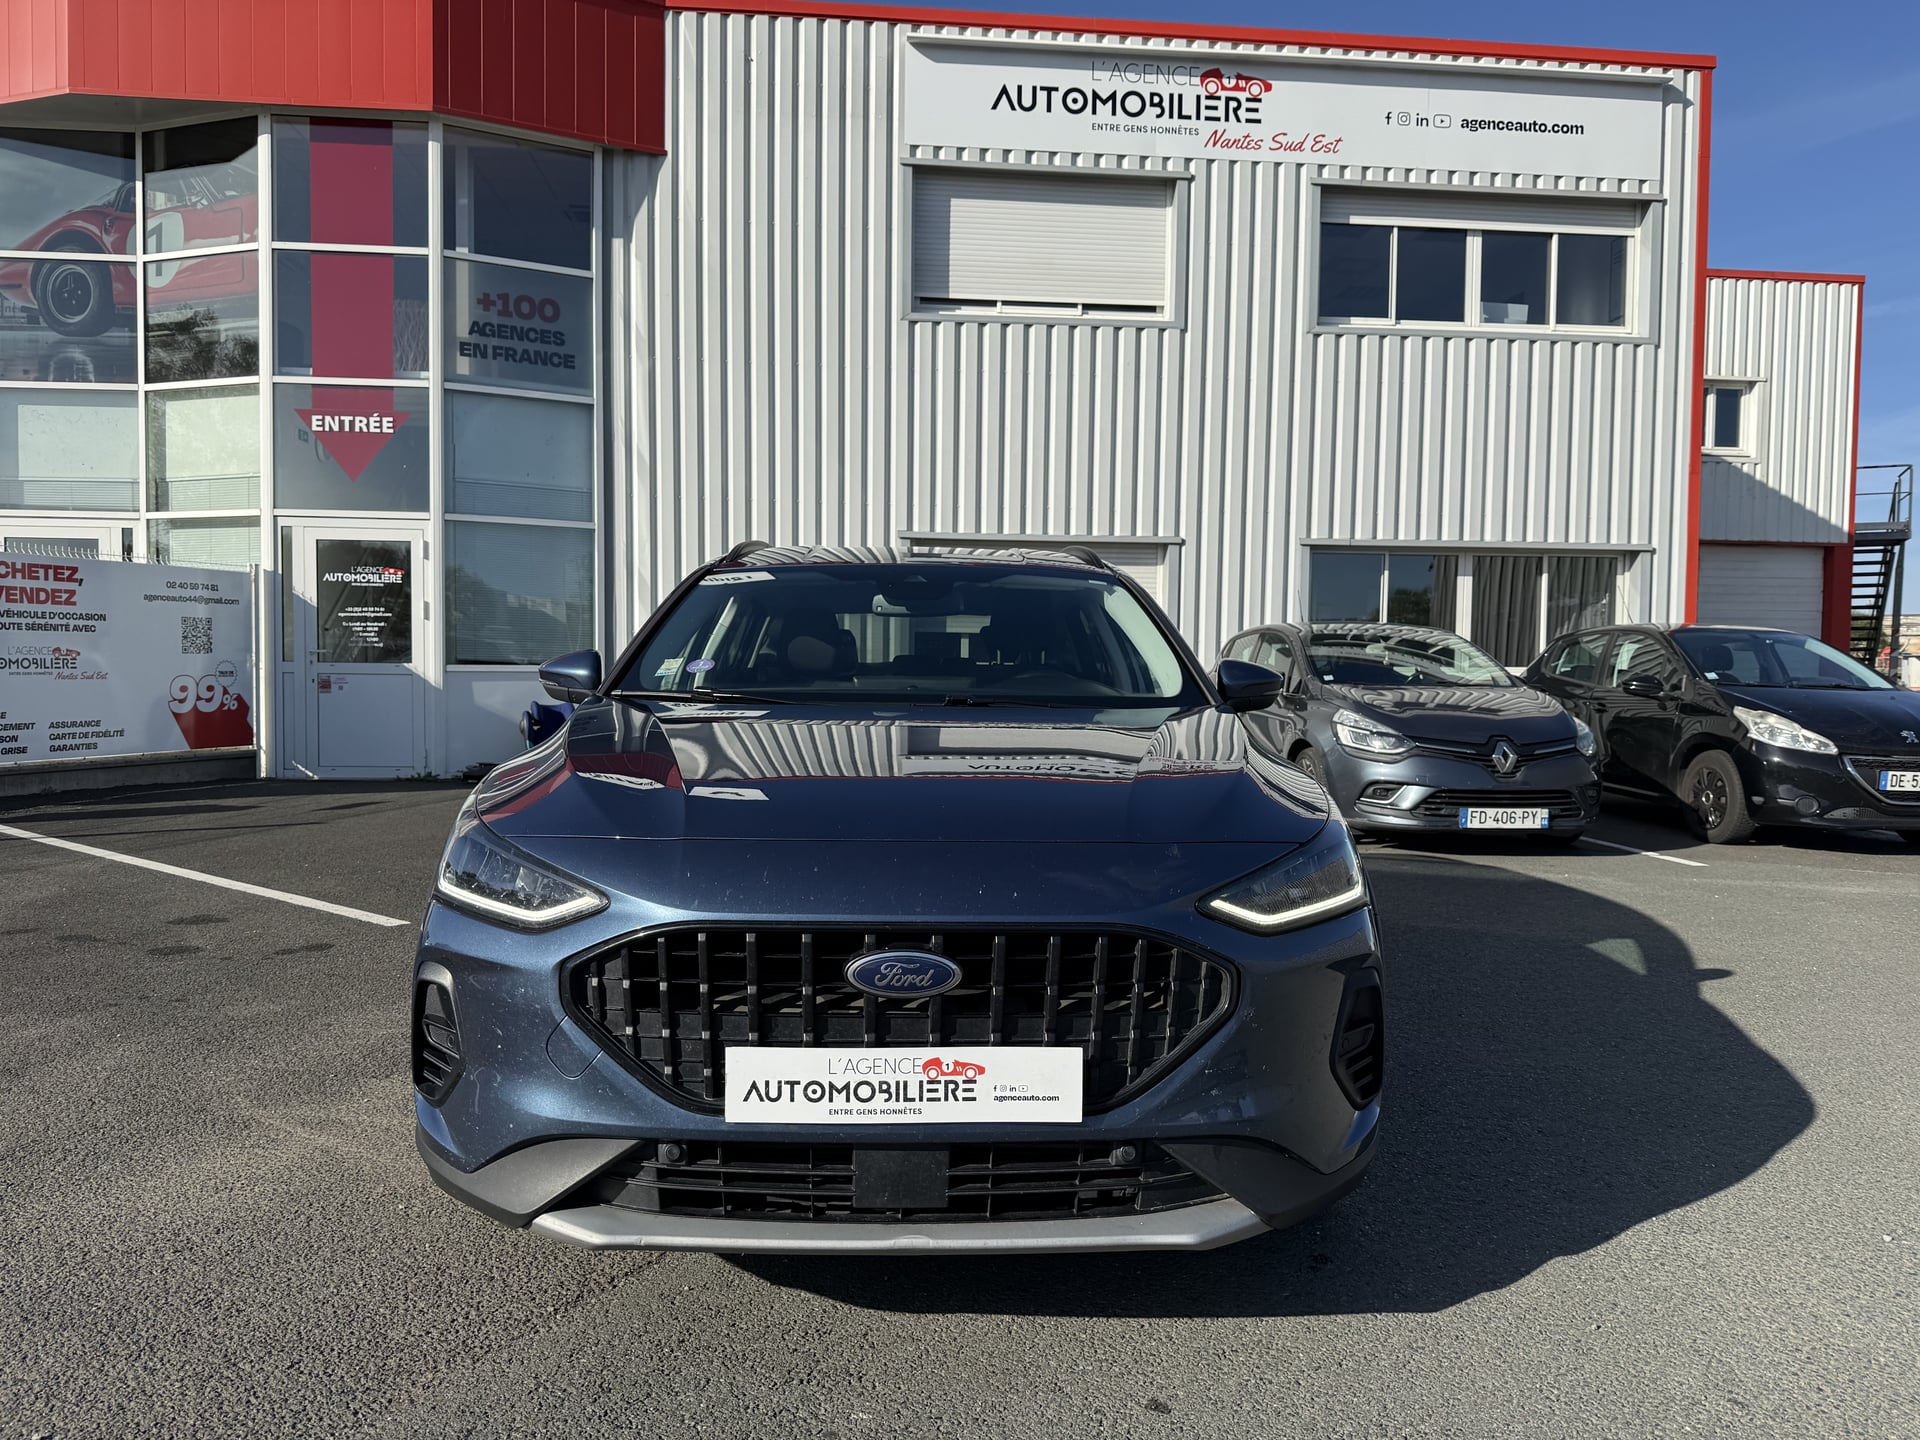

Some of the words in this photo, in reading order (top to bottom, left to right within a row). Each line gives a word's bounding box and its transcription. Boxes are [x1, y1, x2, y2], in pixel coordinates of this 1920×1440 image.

[1091, 61, 1200, 87] L'AGENCE
[1092, 122, 1121, 133] ENTRE
[1123, 124, 1149, 134] GENS
[1150, 125, 1200, 136] HONNÊTES
[1460, 117, 1585, 135] agenceauto.com
[1204, 129, 1264, 151] Nantes
[1269, 132, 1310, 153] Sud
[1311, 134, 1344, 154] Est
[476, 292, 561, 324] +100
[468, 320, 566, 347] AGENCES
[459, 341, 488, 360] EN
[492, 345, 576, 370] FRANCE
[311, 412, 394, 434] ENTRÉE
[166, 580, 177, 589] 02
[178, 581, 189, 590] 40
[201, 583, 210, 591] 74
[143, 593, 240, 606] agenceauto44@gmail.com
[49, 611, 107, 621] D'OCCASION
[25, 621, 70, 632] SÉRÉNITÉ
[72, 624, 97, 633] AVEC
[8, 646, 53, 656] L'AGENCE
[48, 719, 102, 730] ASSURANCE
[49, 732, 77, 741] CARTE
[78, 731, 90, 740] DE
[90, 728, 125, 739] FIDÉLITÉ
[1, 746, 28, 755] GRISE
[49, 742, 98, 753] GARANTIES
[1890, 774, 1920, 788] DE-5
[1469, 810, 1538, 825] FD-406-PY
[874, 962, 935, 987] Ford
[828, 1057, 923, 1075] L'AGENCE
[993, 1094, 1060, 1103] agenceauto.com
[828, 1108, 854, 1116] ENTRE
[856, 1108, 878, 1116] GENS
[880, 1106, 923, 1115] HONNÊTES
